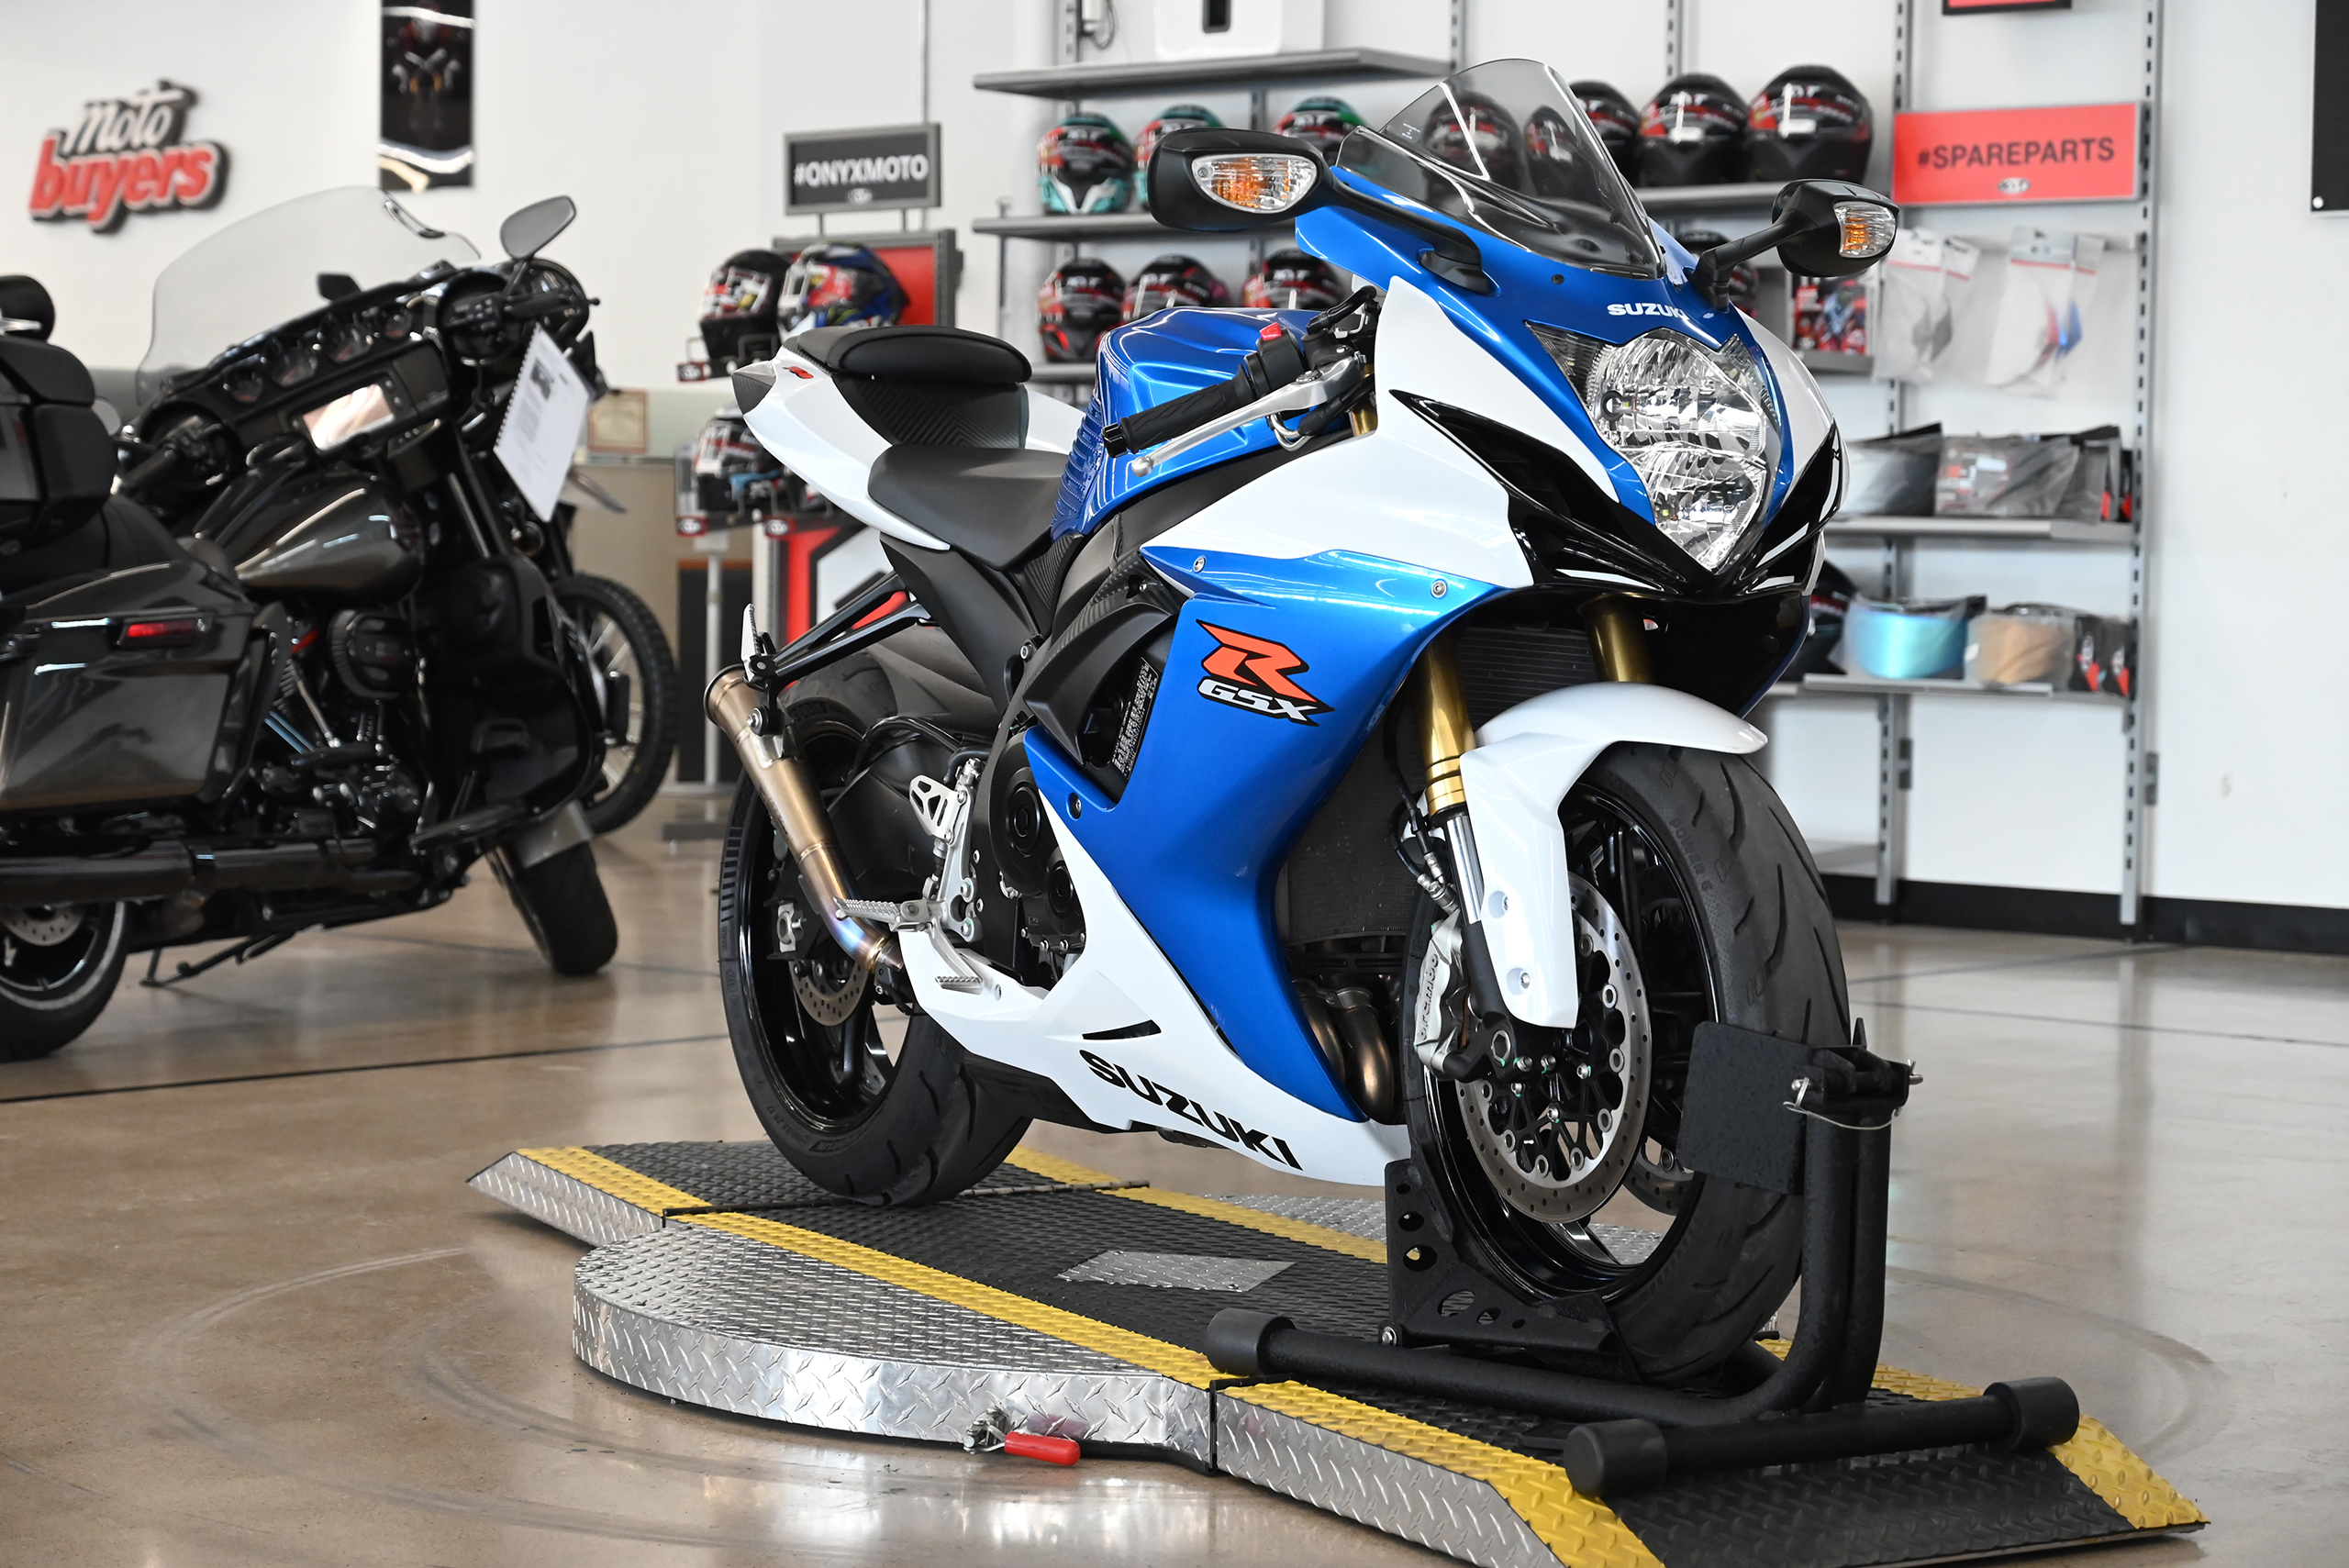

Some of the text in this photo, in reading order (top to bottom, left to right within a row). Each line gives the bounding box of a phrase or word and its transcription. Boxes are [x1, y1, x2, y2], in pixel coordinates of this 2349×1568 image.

[795, 154, 929, 187] #ONYXMOTO
[1918, 137, 2116, 169] #SPAREPARTS
[29, 137, 215, 223] buyers
[1607, 303, 1690, 320] SUZUKI
[1196, 619, 1321, 704] R
[1197, 677, 1319, 723] GSX
[1669, 817, 1707, 875] POWER
[1079, 1050, 1303, 1171] SUZUKI
